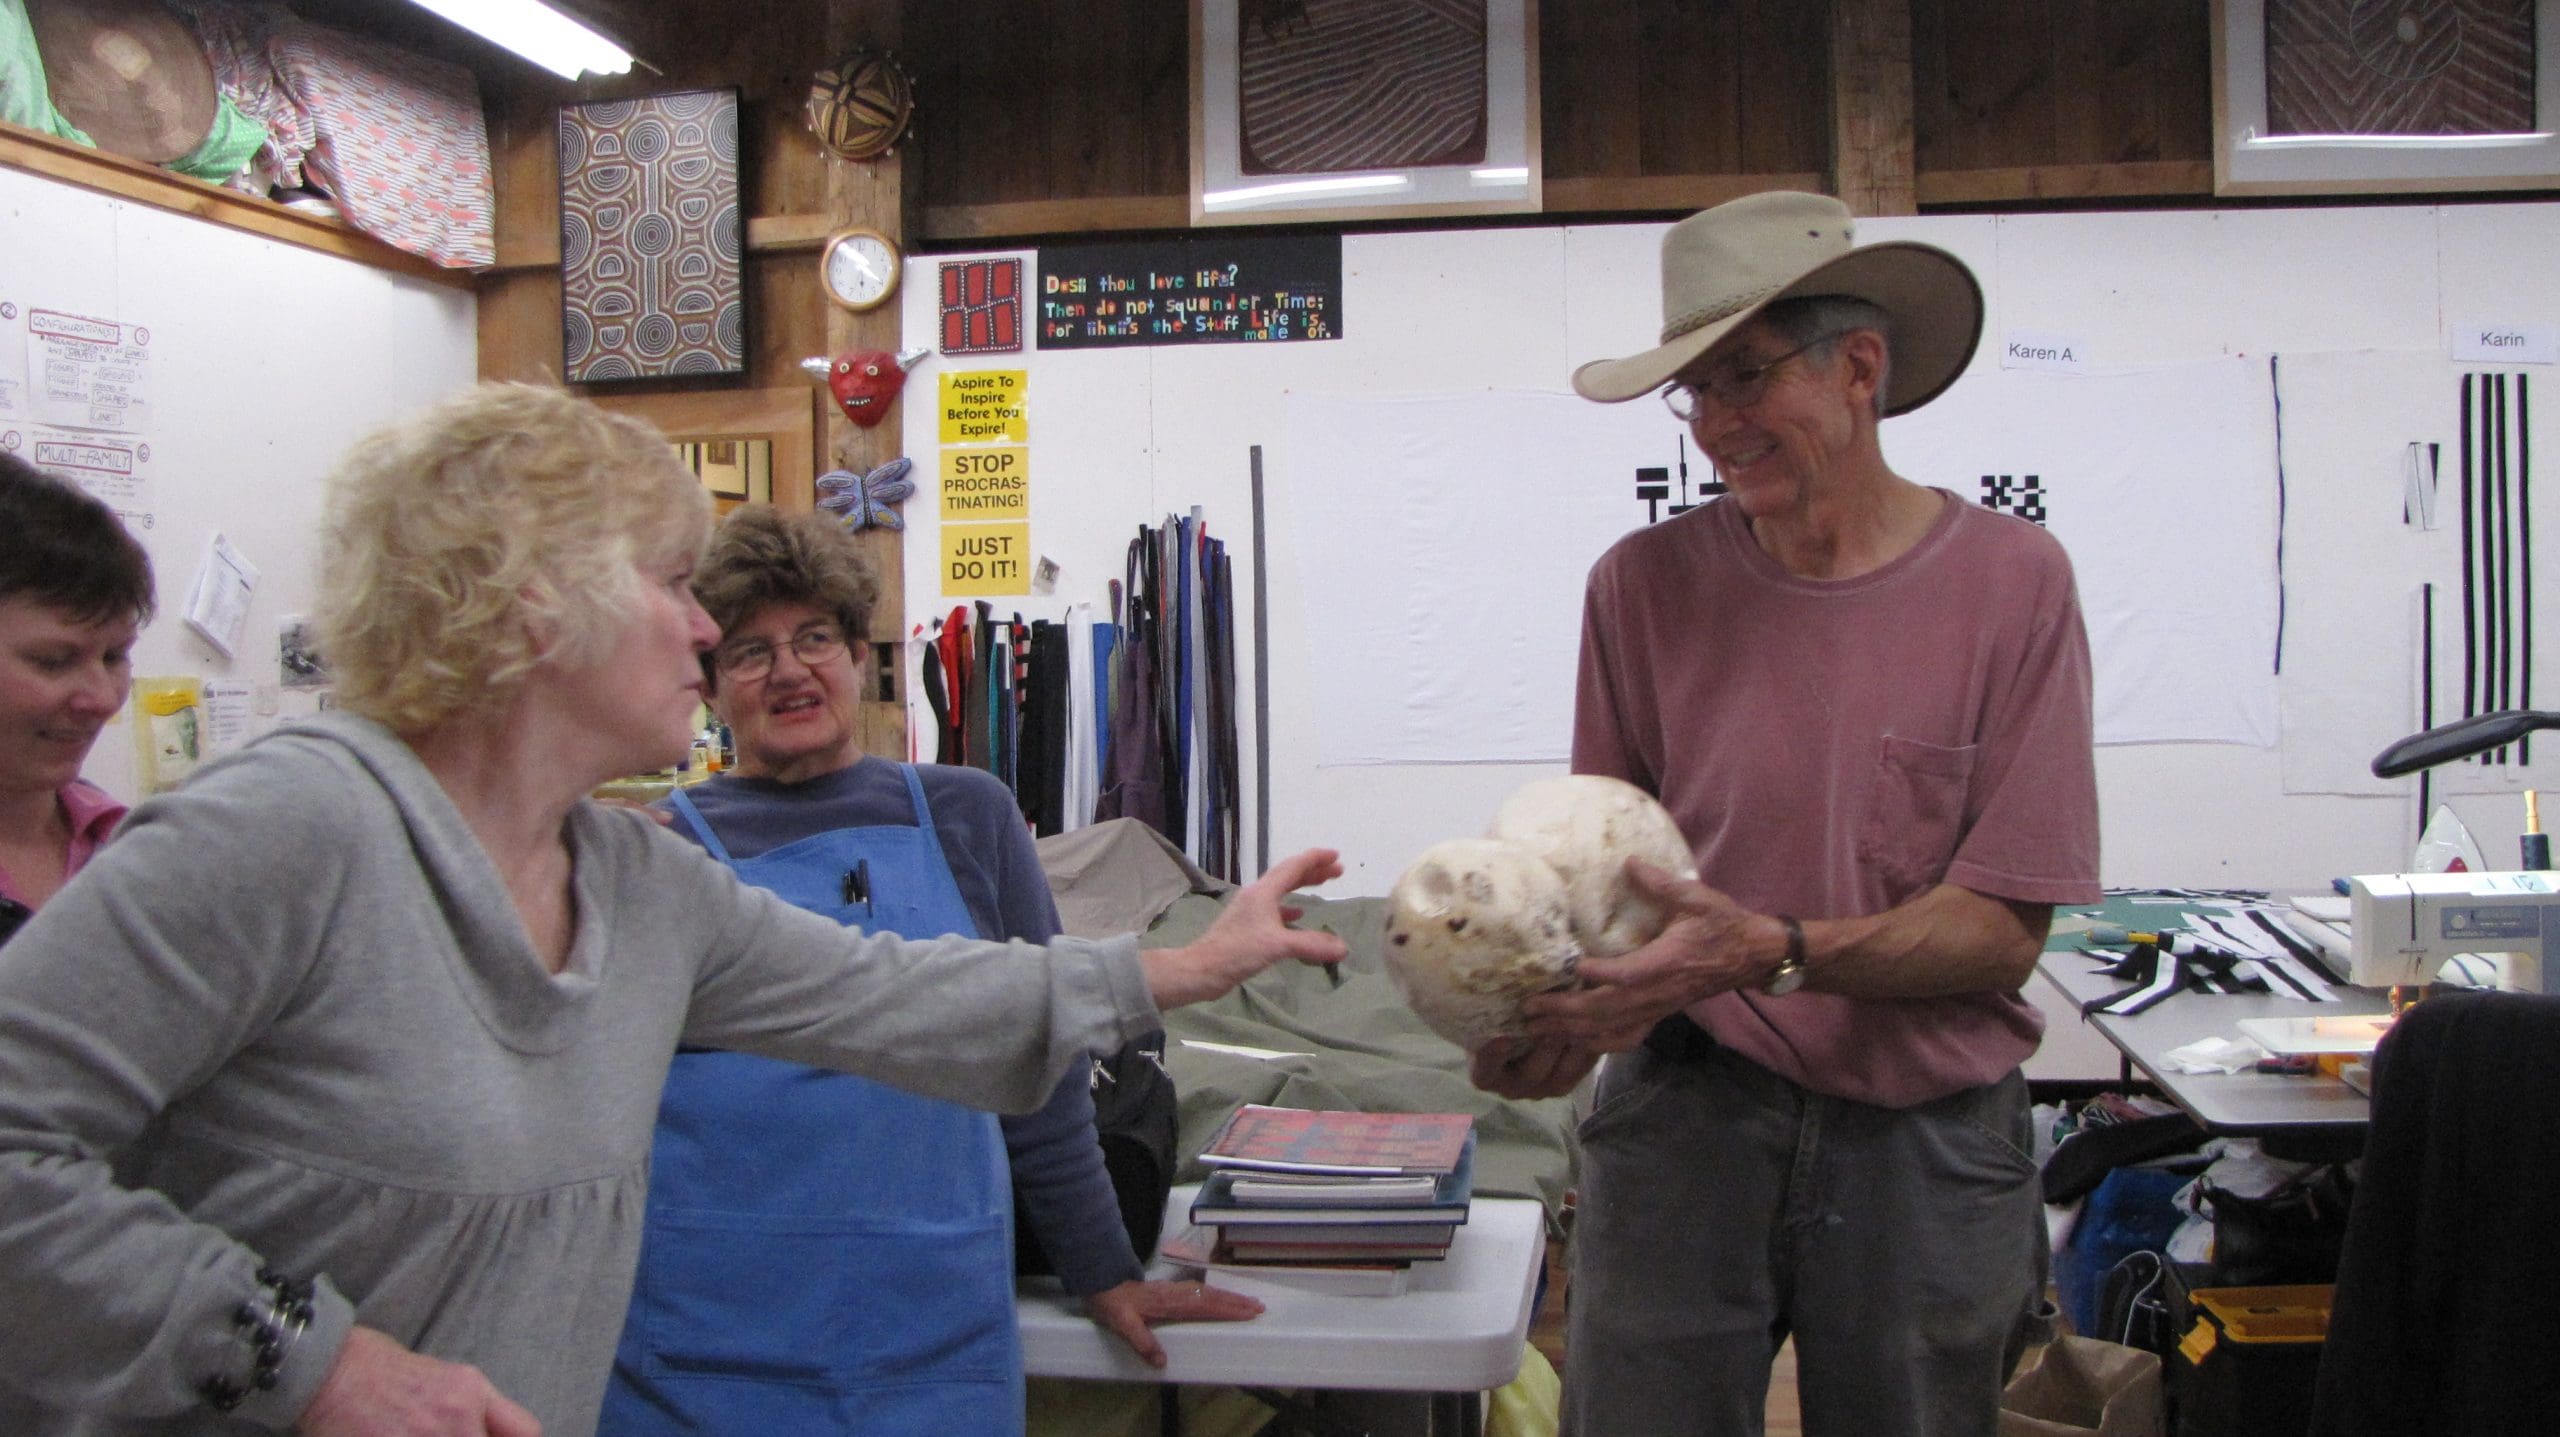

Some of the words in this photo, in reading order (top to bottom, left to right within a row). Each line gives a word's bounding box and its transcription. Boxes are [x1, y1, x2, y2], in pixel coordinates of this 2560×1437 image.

[1100, 273, 1135, 293] thou
[1150, 272, 1185, 290] love
[1196, 263, 1239, 288] life?
[1045, 302, 1086, 318] Then
[1096, 299, 1117, 316] do
[1126, 299, 1154, 315] not
[1166, 293, 1261, 324] squander
[1046, 320, 1074, 338] for
[1152, 319, 1183, 334] the
[1196, 314, 1239, 332] Stuff
[1251, 309, 1289, 328] Life
[2481, 331, 2525, 347] Karin
[2009, 342, 2057, 360] Karen
[2061, 347, 2078, 362] A.
[952, 376, 995, 391] Aspire
[998, 376, 1014, 387] To
[961, 391, 1005, 406] Inspire
[947, 408, 990, 420] Before
[994, 407, 1019, 419] You
[961, 422, 1006, 437] Expire!
[40, 444, 130, 469] MULTI-FAMILY
[955, 454, 1014, 474] STOP
[944, 476, 1027, 492] PROCRAS-
[947, 494, 1024, 509] TINATING!
[955, 536, 1013, 557] JUST
[952, 561, 984, 580] DO
[991, 559, 1017, 579] IT!
